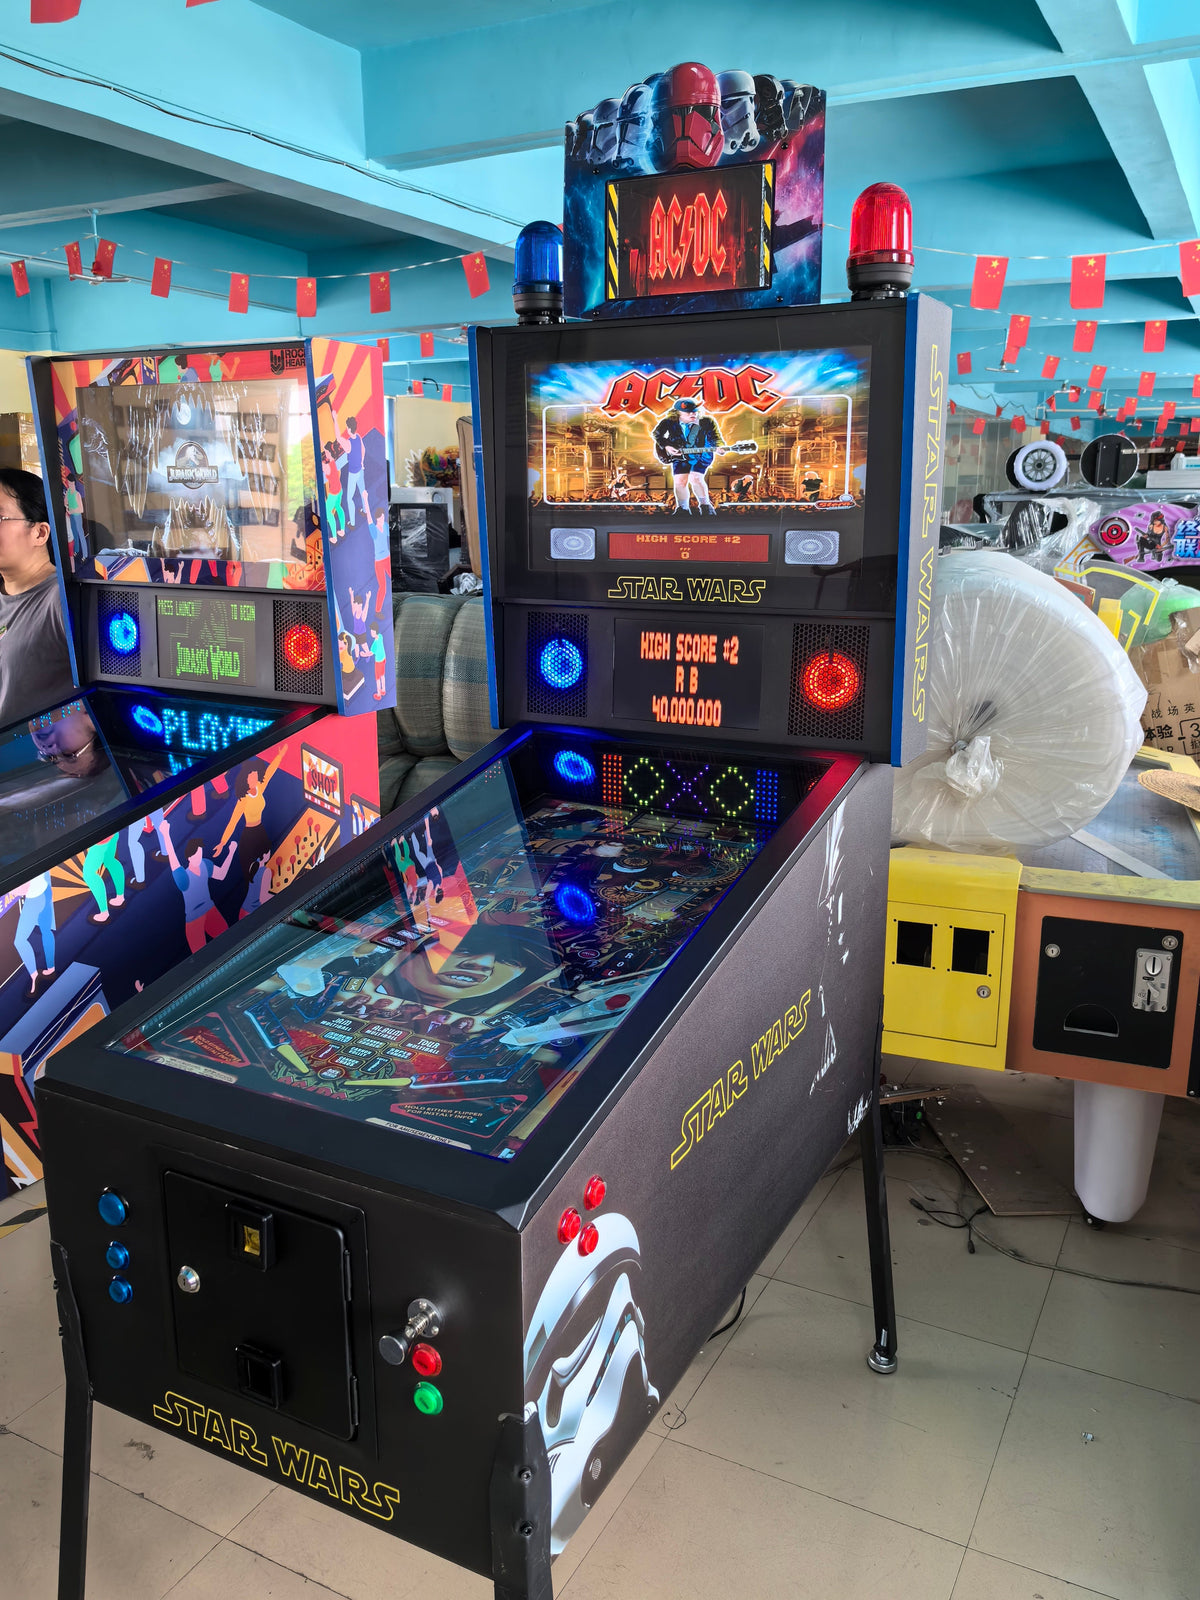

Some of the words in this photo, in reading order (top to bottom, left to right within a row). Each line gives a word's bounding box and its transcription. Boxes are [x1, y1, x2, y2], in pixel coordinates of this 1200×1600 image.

[285, 348, 305, 358] ROC
[922, 344, 943, 538] STAR
[636, 534, 668, 543] HIGH
[674, 535, 717, 544] SCORE
[724, 536, 741, 544] #2
[1174, 519, 1200, 539] 终
[1172, 538, 1200, 558] 联
[608, 576, 683, 600] STAR
[687, 578, 766, 604] WARS
[640, 631, 671, 660] HIGH
[676, 633, 718, 663] SCORE
[723, 635, 740, 665] #2
[912, 546, 934, 722] WARS
[176, 642, 209, 677] JURASSIC
[209, 644, 240, 680] WORLD
[675, 665, 684, 693] R
[689, 666, 698, 694] B
[311, 769, 336, 799] SHOT
[417, 1038, 441, 1049] TOUR
[671, 1060, 748, 1170] STAR
[751, 988, 811, 1080] WARS
[385, 1121, 398, 1129] FOR
[398, 1126, 435, 1140] AMUSEMENT
[435, 1134, 452, 1144] ONLY
[153, 1391, 268, 1466] STAR
[271, 1436, 400, 1520] WARS
